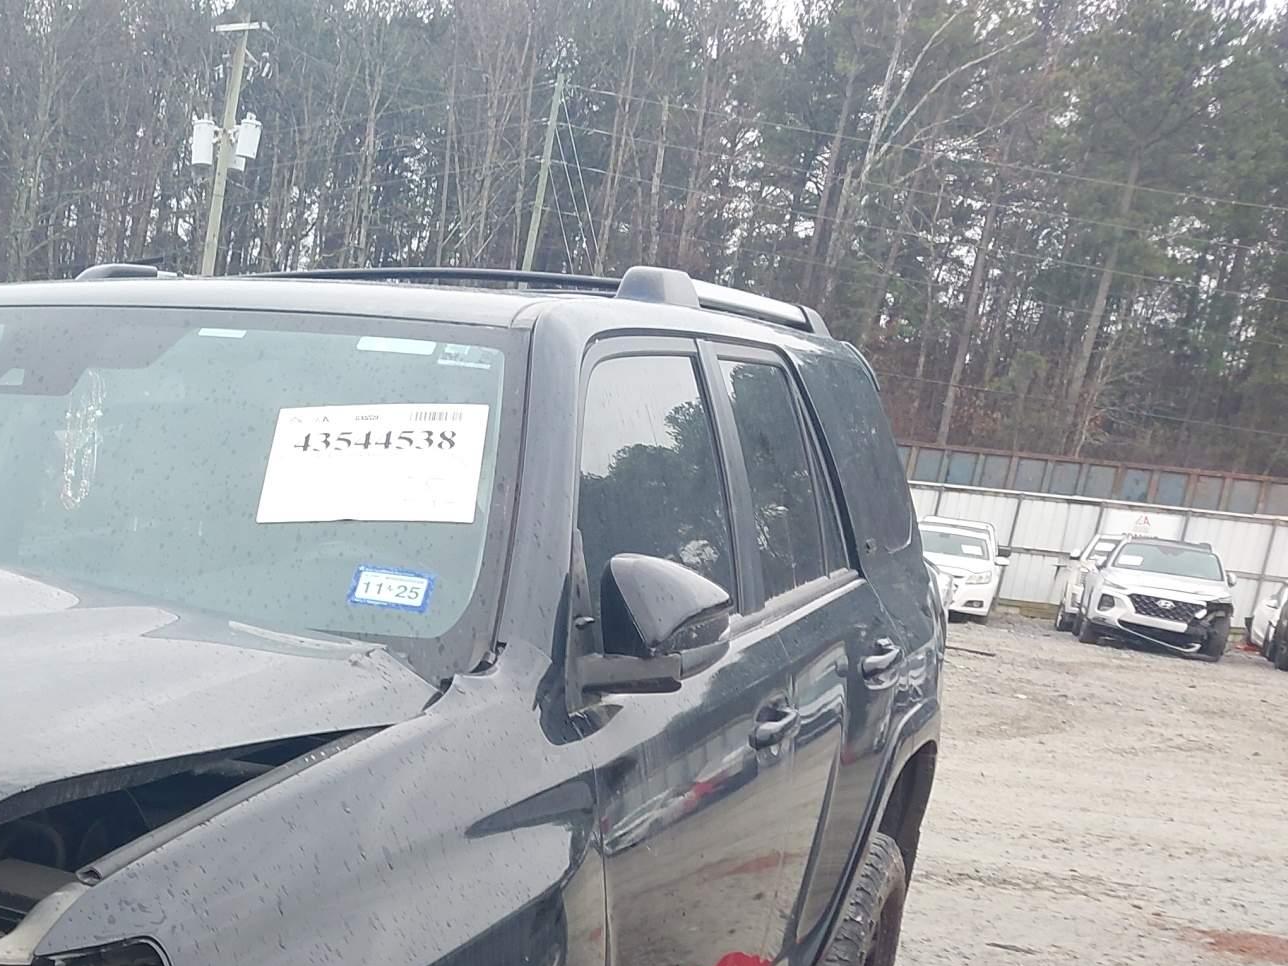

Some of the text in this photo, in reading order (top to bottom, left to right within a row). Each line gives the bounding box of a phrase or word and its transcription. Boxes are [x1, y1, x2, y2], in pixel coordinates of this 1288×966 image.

[293, 430, 457, 452] 43544538
[363, 581, 421, 600] 11 25
